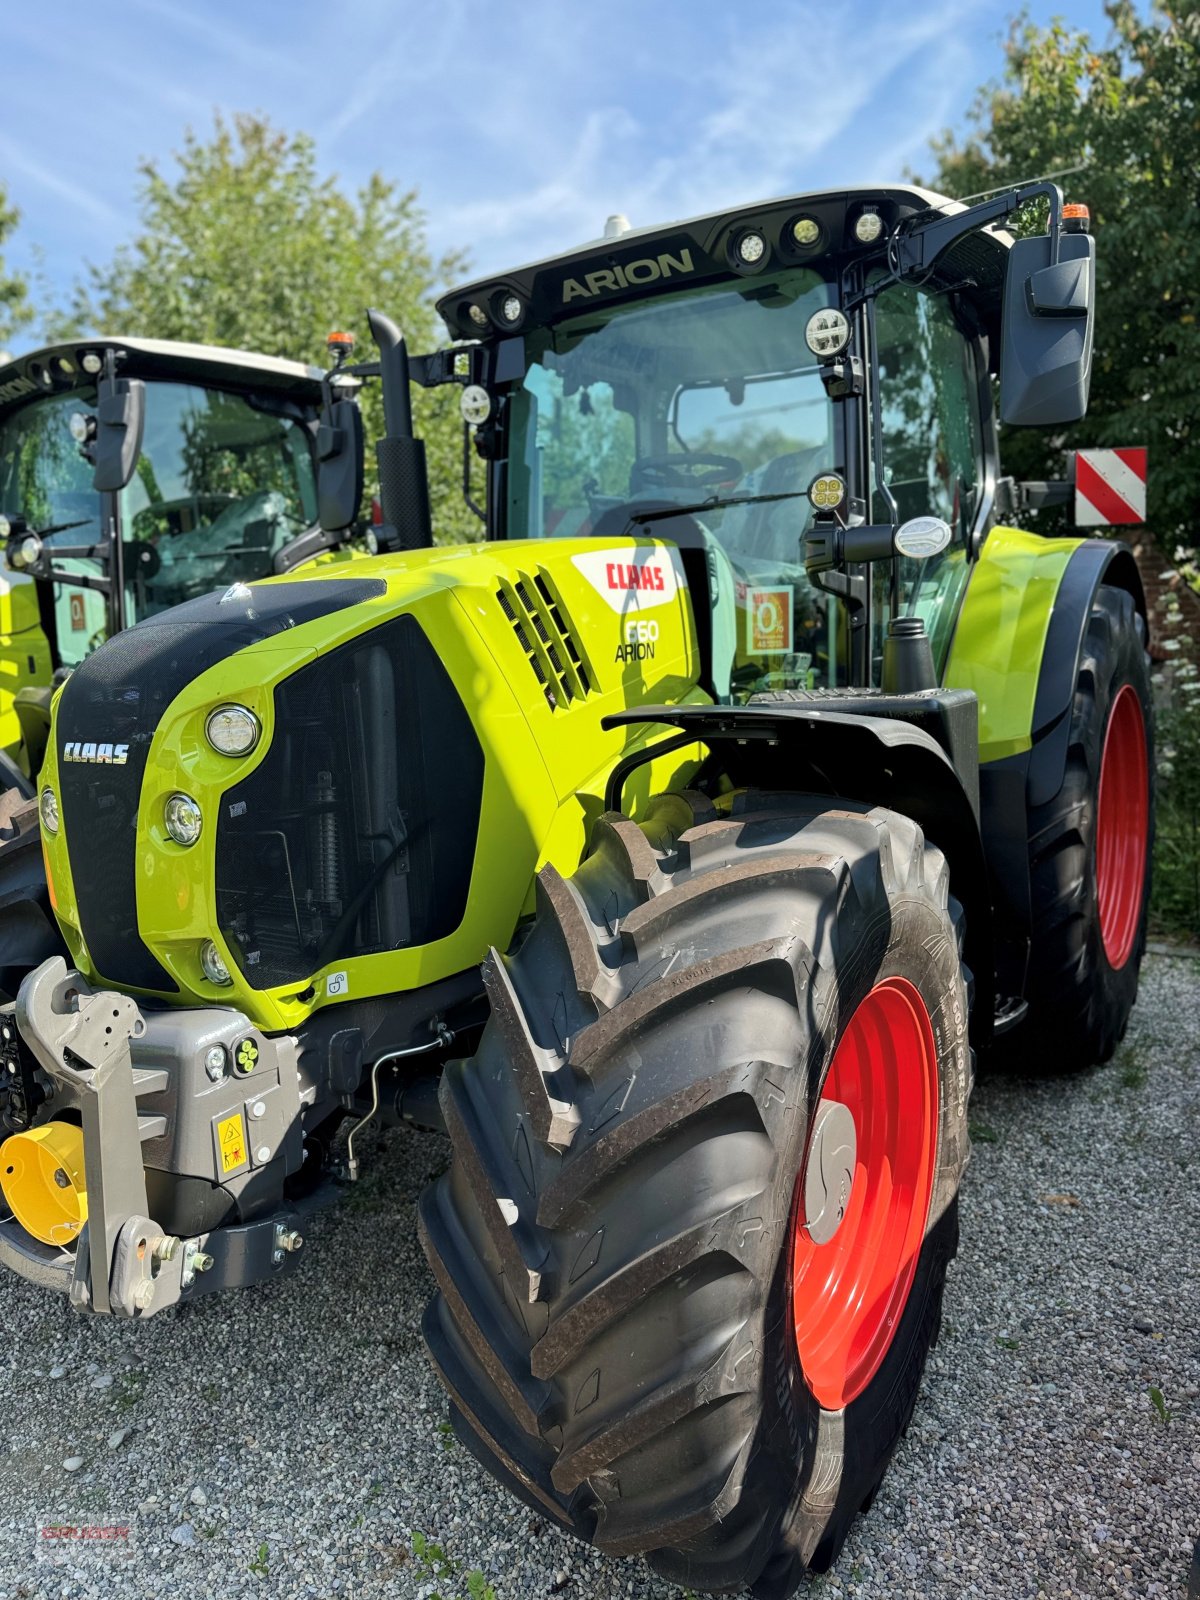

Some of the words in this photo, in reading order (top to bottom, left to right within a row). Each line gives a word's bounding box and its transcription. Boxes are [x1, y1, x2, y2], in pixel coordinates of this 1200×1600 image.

[562, 248, 695, 304] ARION
[606, 563, 665, 591] CLAAS
[625, 620, 659, 642] 660
[615, 642, 655, 663] ARION
[64, 743, 129, 765] CLAAS
